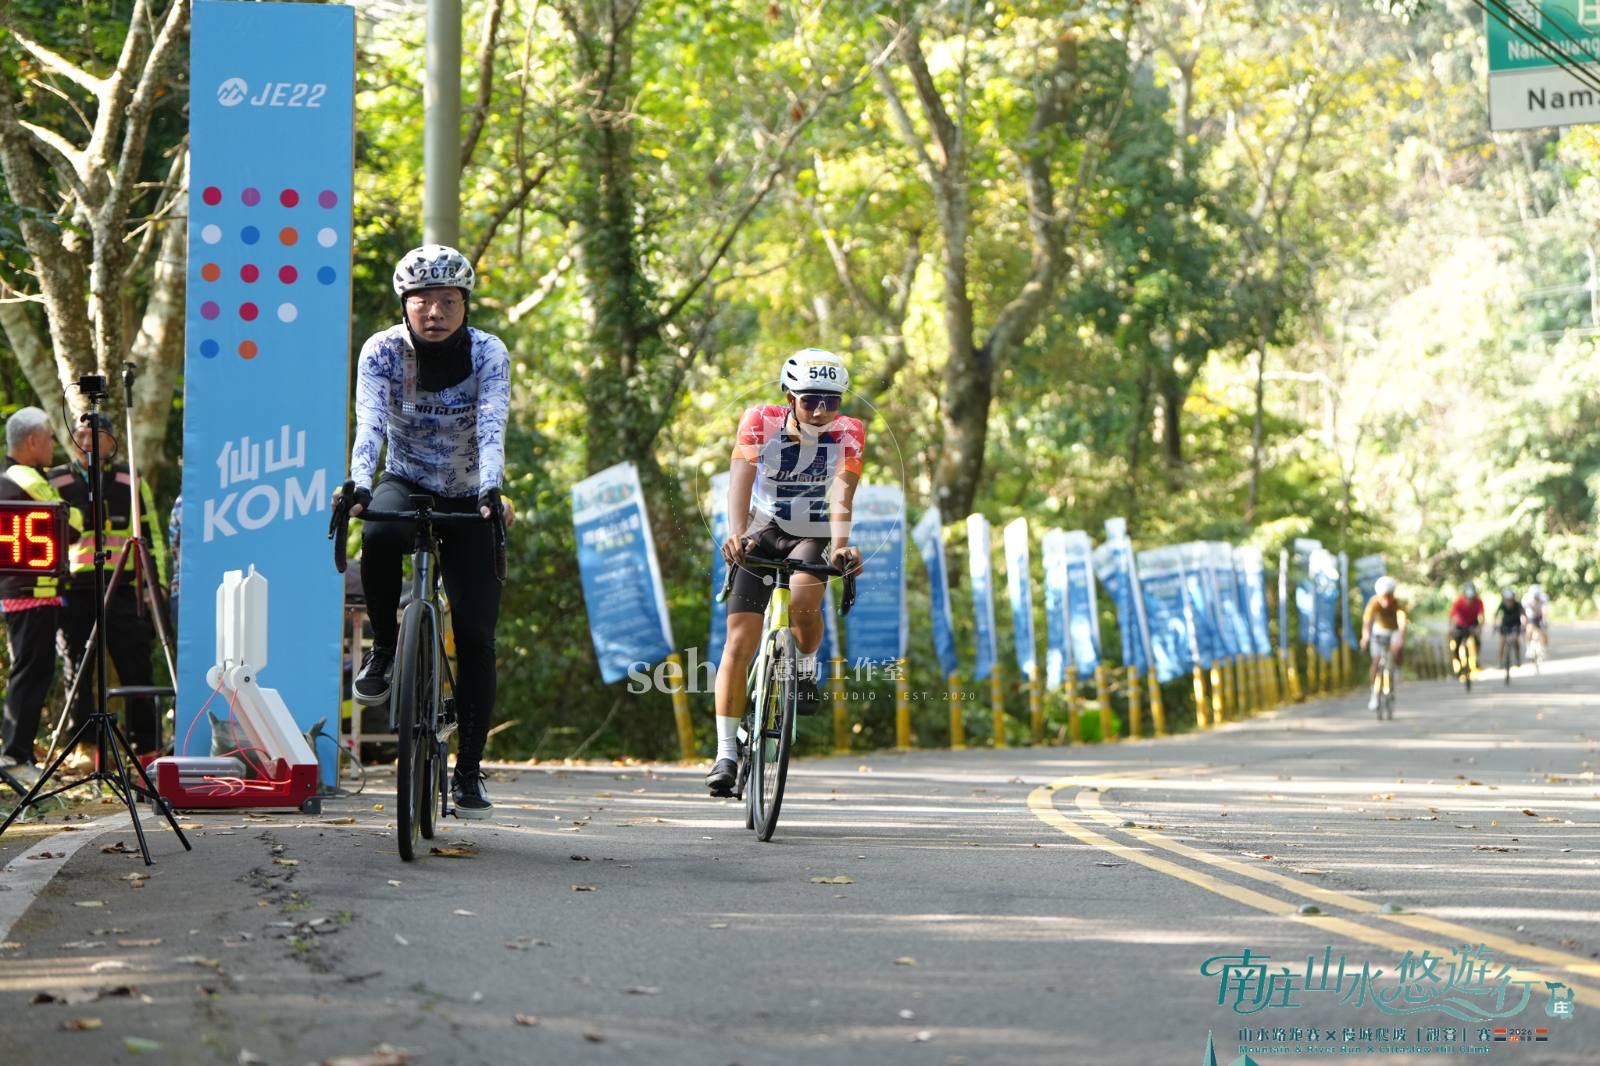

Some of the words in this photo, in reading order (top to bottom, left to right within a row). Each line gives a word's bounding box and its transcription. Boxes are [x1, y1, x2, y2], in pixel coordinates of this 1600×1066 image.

[251, 82, 327, 108] JE22
[1528, 87, 1600, 111] Nam
[809, 366, 837, 380] 546
[216, 424, 306, 489] 仙山
[203, 468, 326, 543] KOM
